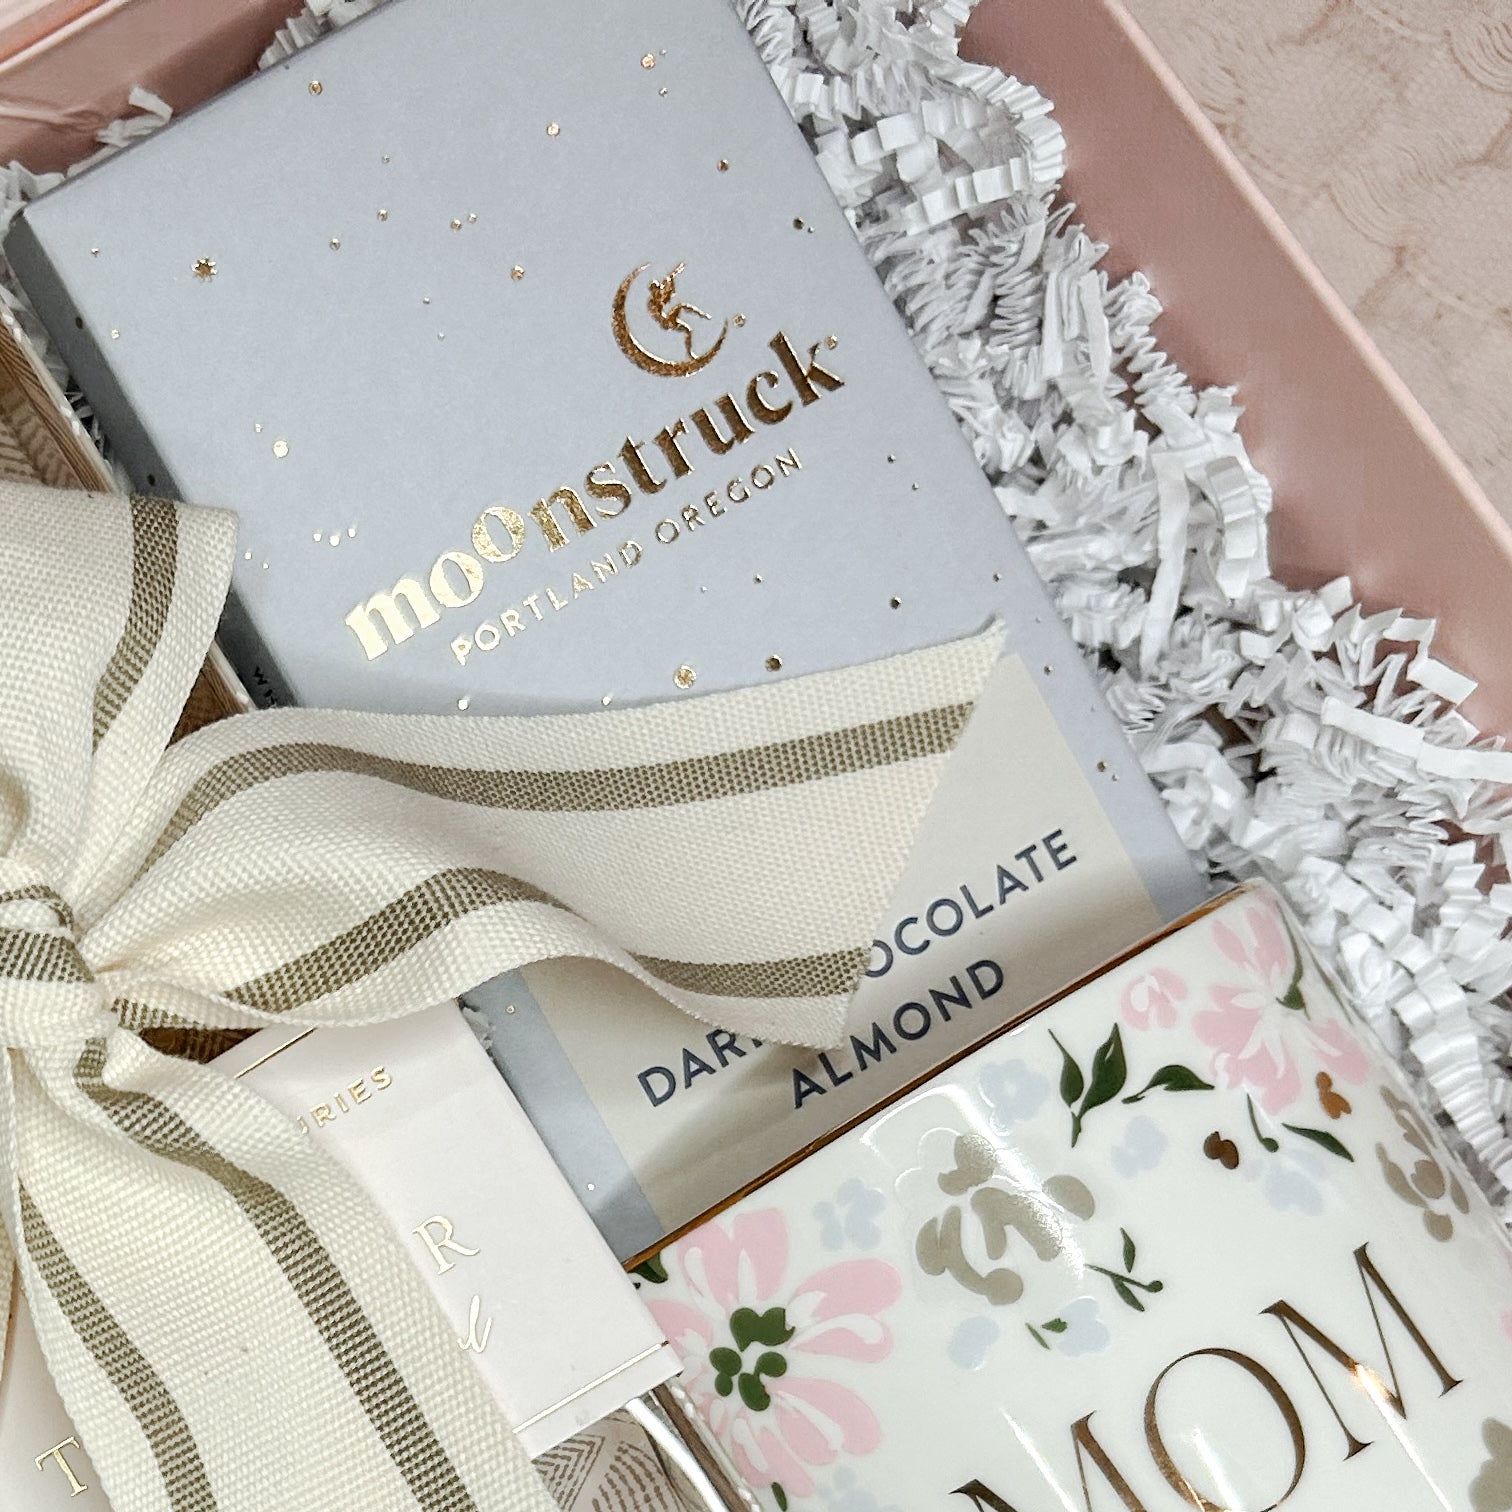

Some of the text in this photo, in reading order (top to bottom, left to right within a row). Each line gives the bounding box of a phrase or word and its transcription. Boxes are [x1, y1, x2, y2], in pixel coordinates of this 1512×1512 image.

[345, 331, 845, 661] moonstruck
[450, 447, 803, 666] PORTLAND OREGON
[637, 1028, 764, 1108] DAR
[792, 959, 1005, 1110] ALMOND
